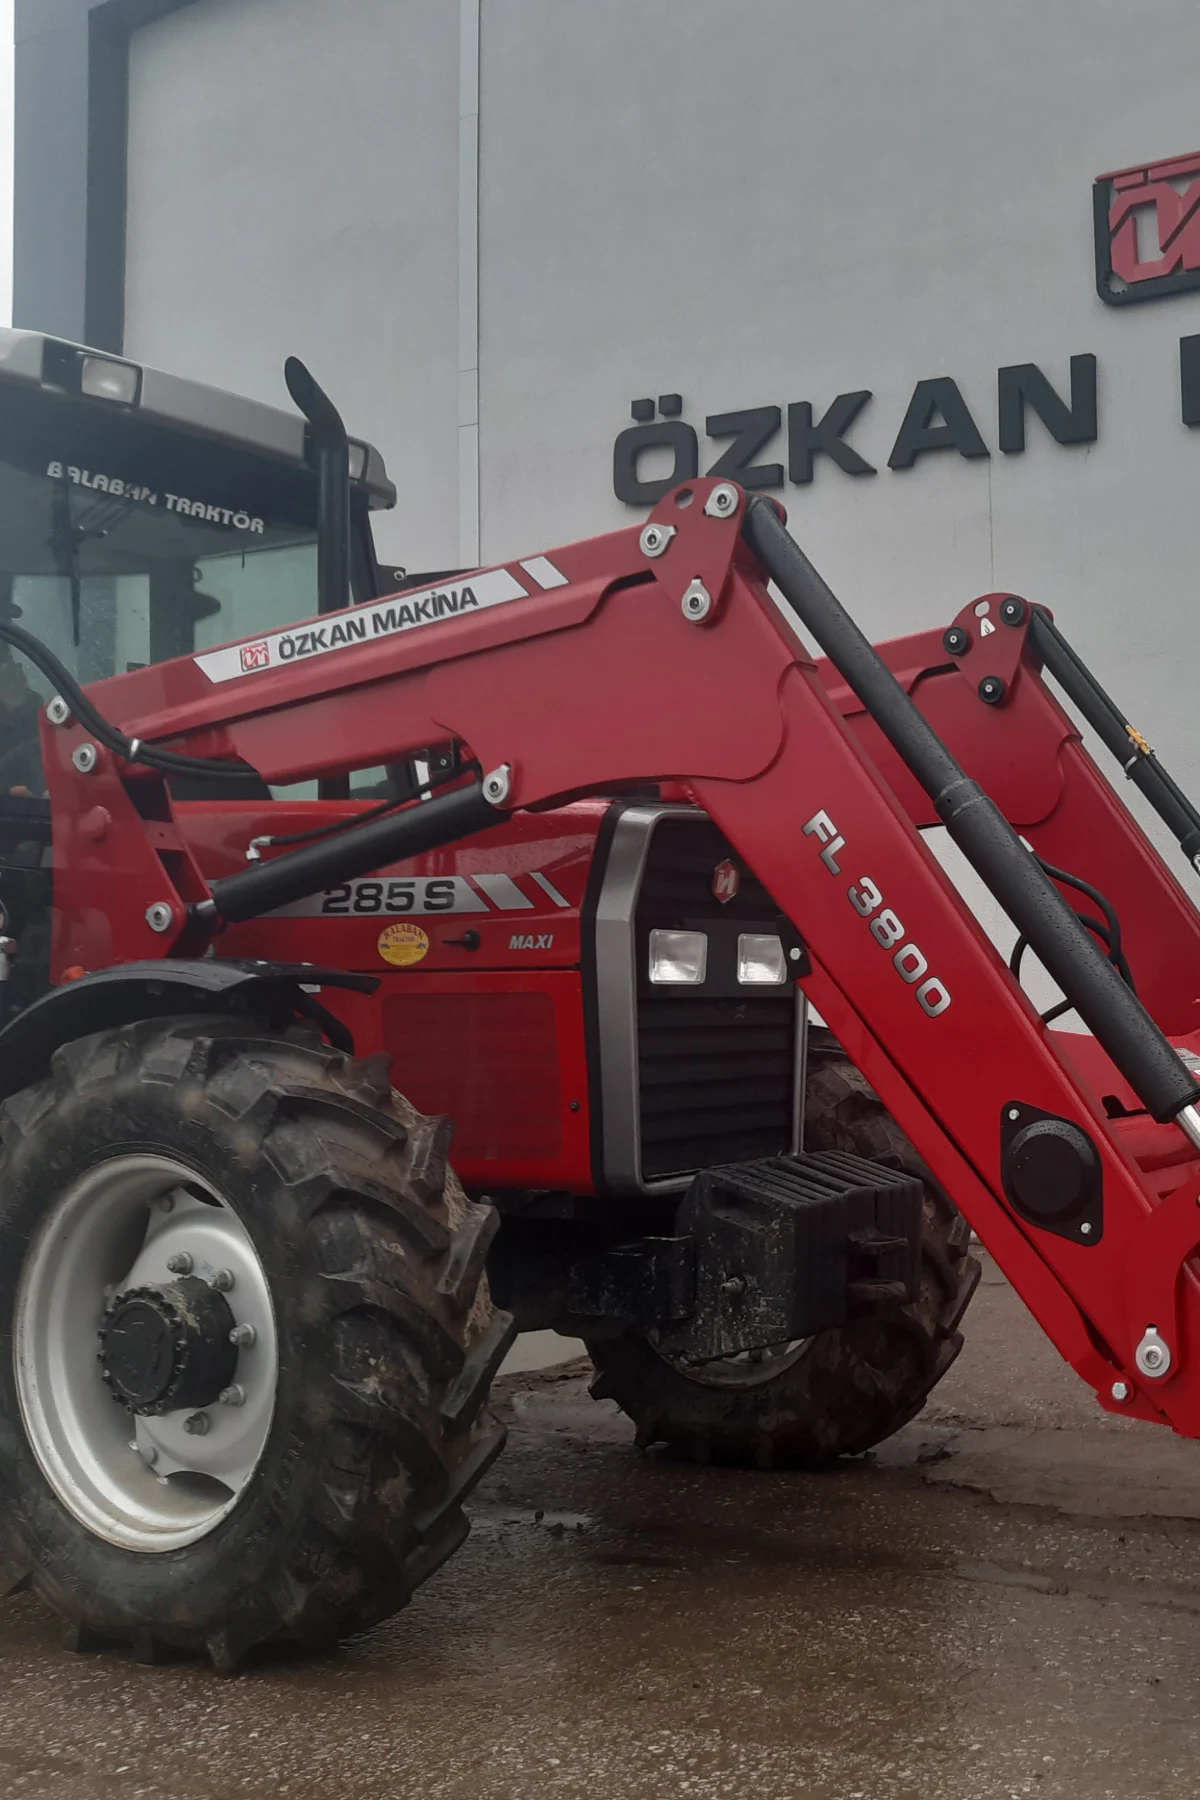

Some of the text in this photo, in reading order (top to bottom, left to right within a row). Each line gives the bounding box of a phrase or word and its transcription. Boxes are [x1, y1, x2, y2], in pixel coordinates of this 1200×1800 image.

[613, 353, 1097, 507] ÖZKAN
[165, 493, 265, 534] TRAKTÖR
[278, 617, 366, 660] ÖZKAN
[372, 587, 479, 634] MAKİNA
[509, 934, 554, 949] MAXI
[802, 808, 952, 1018] FL 3800
